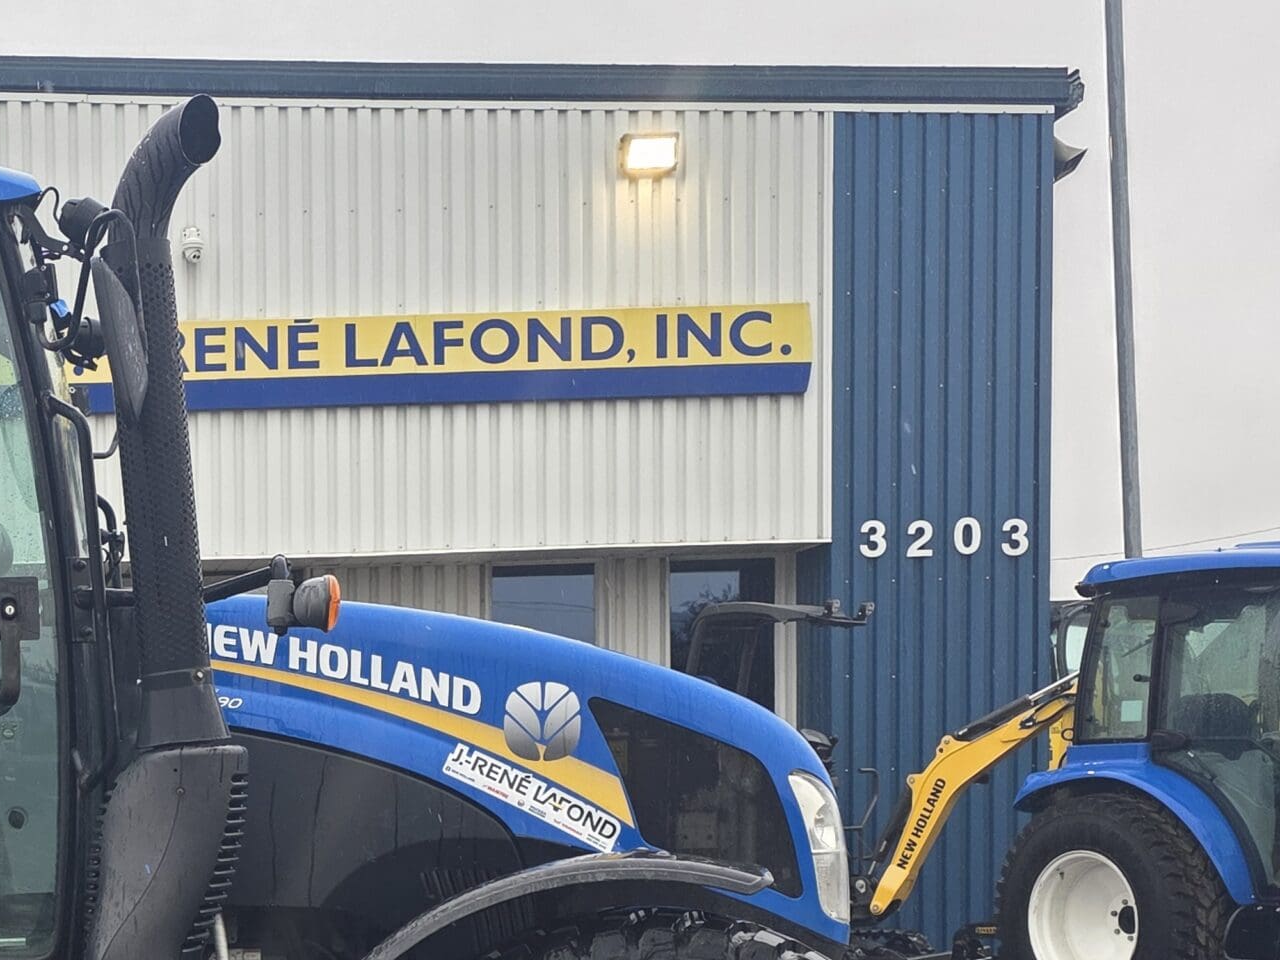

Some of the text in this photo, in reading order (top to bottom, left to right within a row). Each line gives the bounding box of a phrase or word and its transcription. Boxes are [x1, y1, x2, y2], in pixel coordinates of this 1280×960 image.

[344, 316, 636, 368] LAFOND,
[656, 310, 793, 359] INC.
[859, 516, 1030, 559] 3203
[288, 636, 482, 715] HOLLAND
[451, 748, 617, 840] J.-RENÉ LAFOND
[896, 778, 947, 871] NEW HOLLAND
